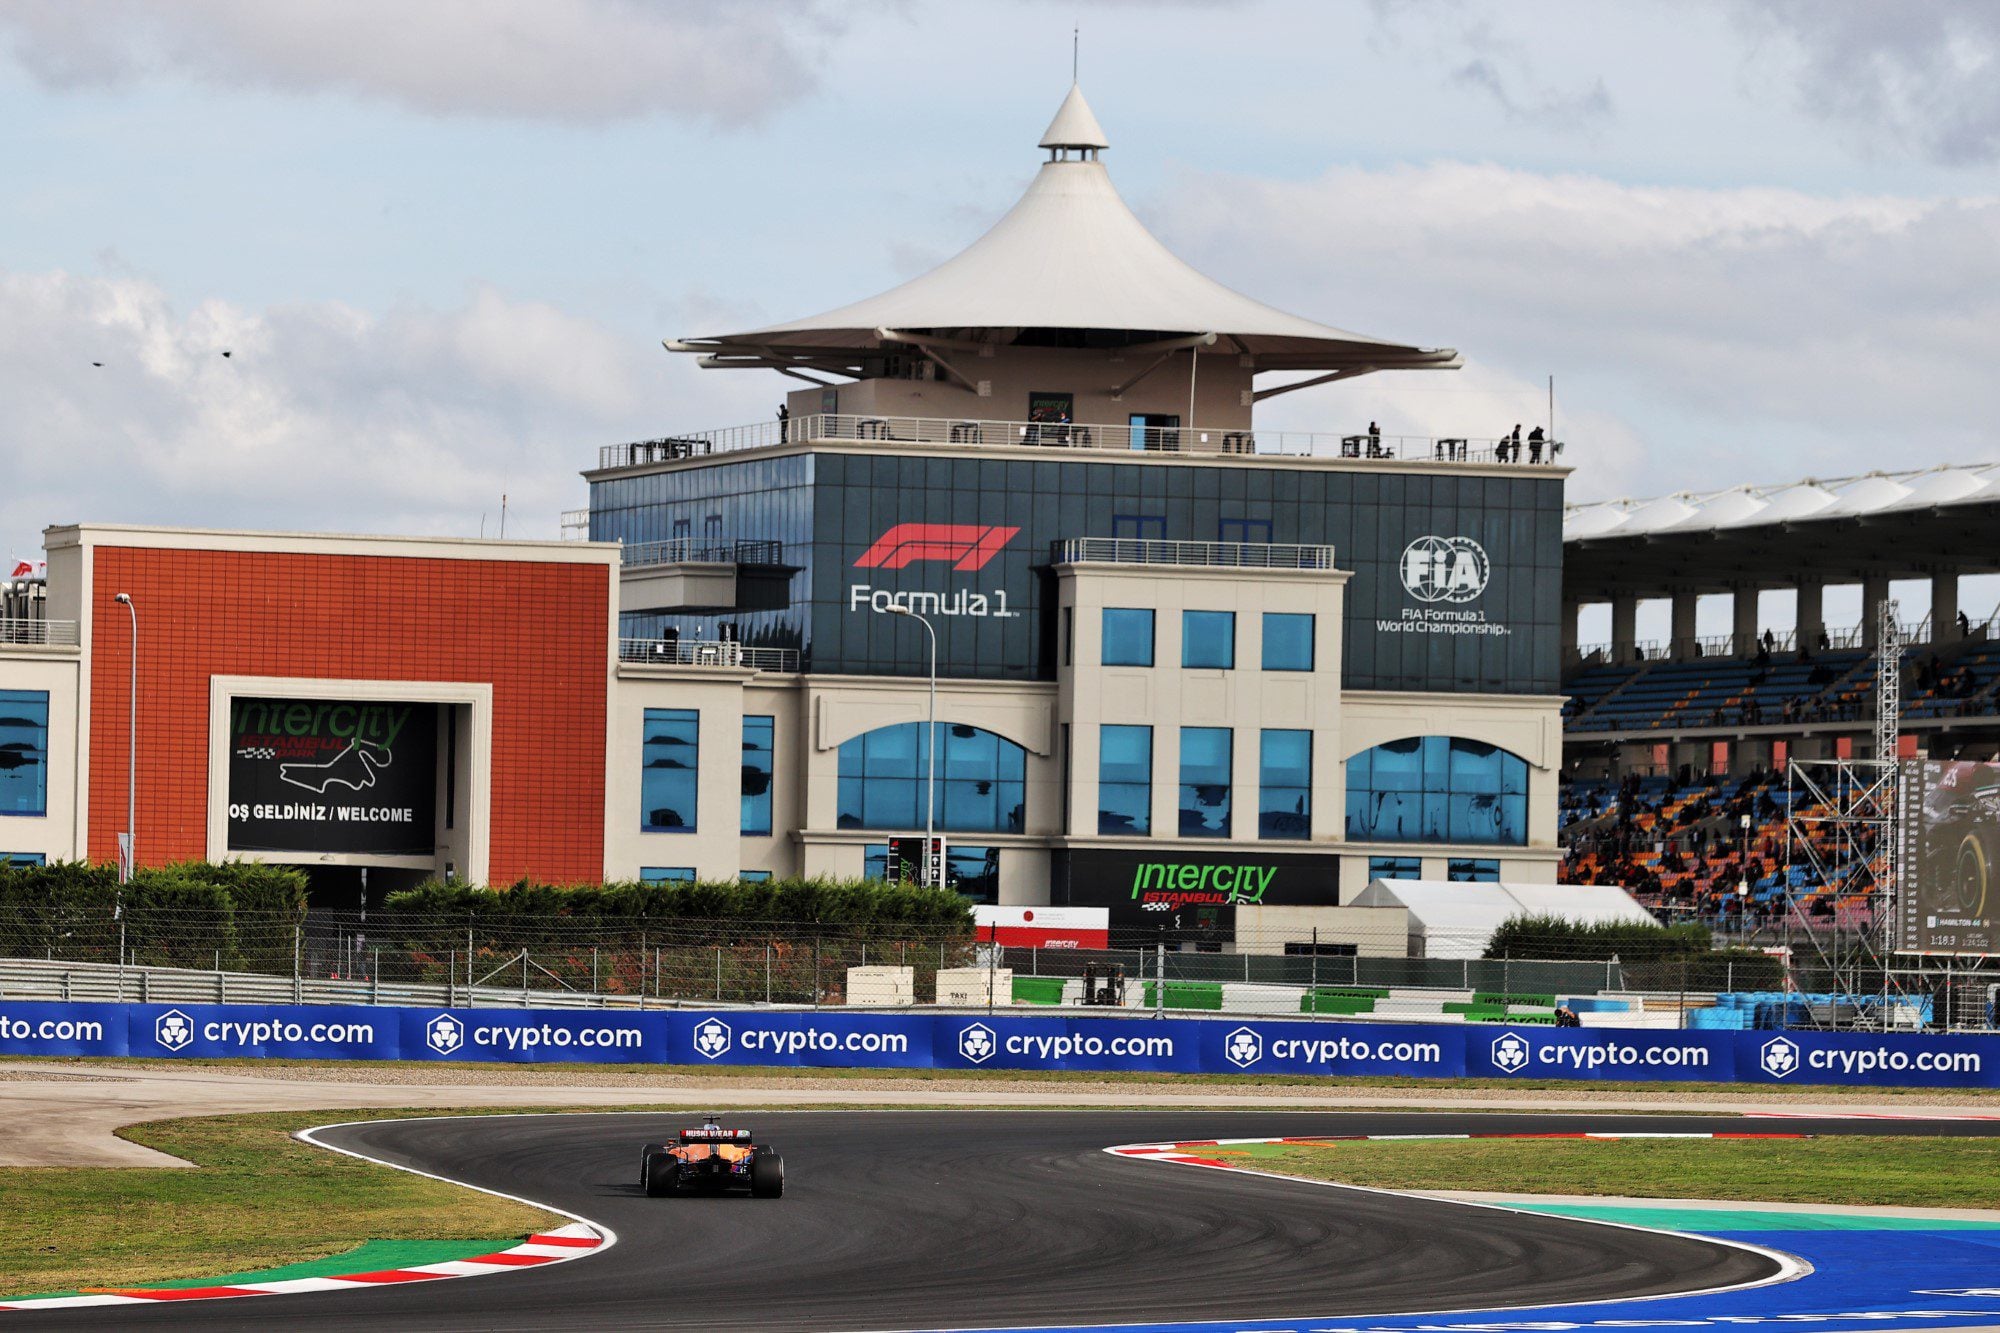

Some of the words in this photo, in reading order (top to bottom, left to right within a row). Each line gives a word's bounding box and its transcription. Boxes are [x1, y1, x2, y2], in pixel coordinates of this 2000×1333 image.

[850, 584, 988, 617] Formula
[993, 589, 1012, 617] 1
[1376, 620, 1414, 633] World
[1415, 621, 1504, 636] Championship
[1402, 608, 1423, 620] FIA
[1424, 609, 1477, 622] Formula
[1477, 610, 1486, 622] 1
[240, 735, 350, 751] ISTANBUL
[253, 803, 326, 821] GELDİNİZ
[337, 807, 412, 822] WELCOME
[1143, 892, 1226, 904] ISTANBUL
[203, 1019, 373, 1046] crypto.com
[473, 1023, 642, 1051] crypto.com
[740, 1028, 908, 1055] crypto.com
[1006, 1032, 1173, 1060] crypto.com
[1272, 1037, 1440, 1064] crypto.com
[1538, 1042, 1709, 1069] crypto.com
[1808, 1047, 1980, 1074] crypto.com
